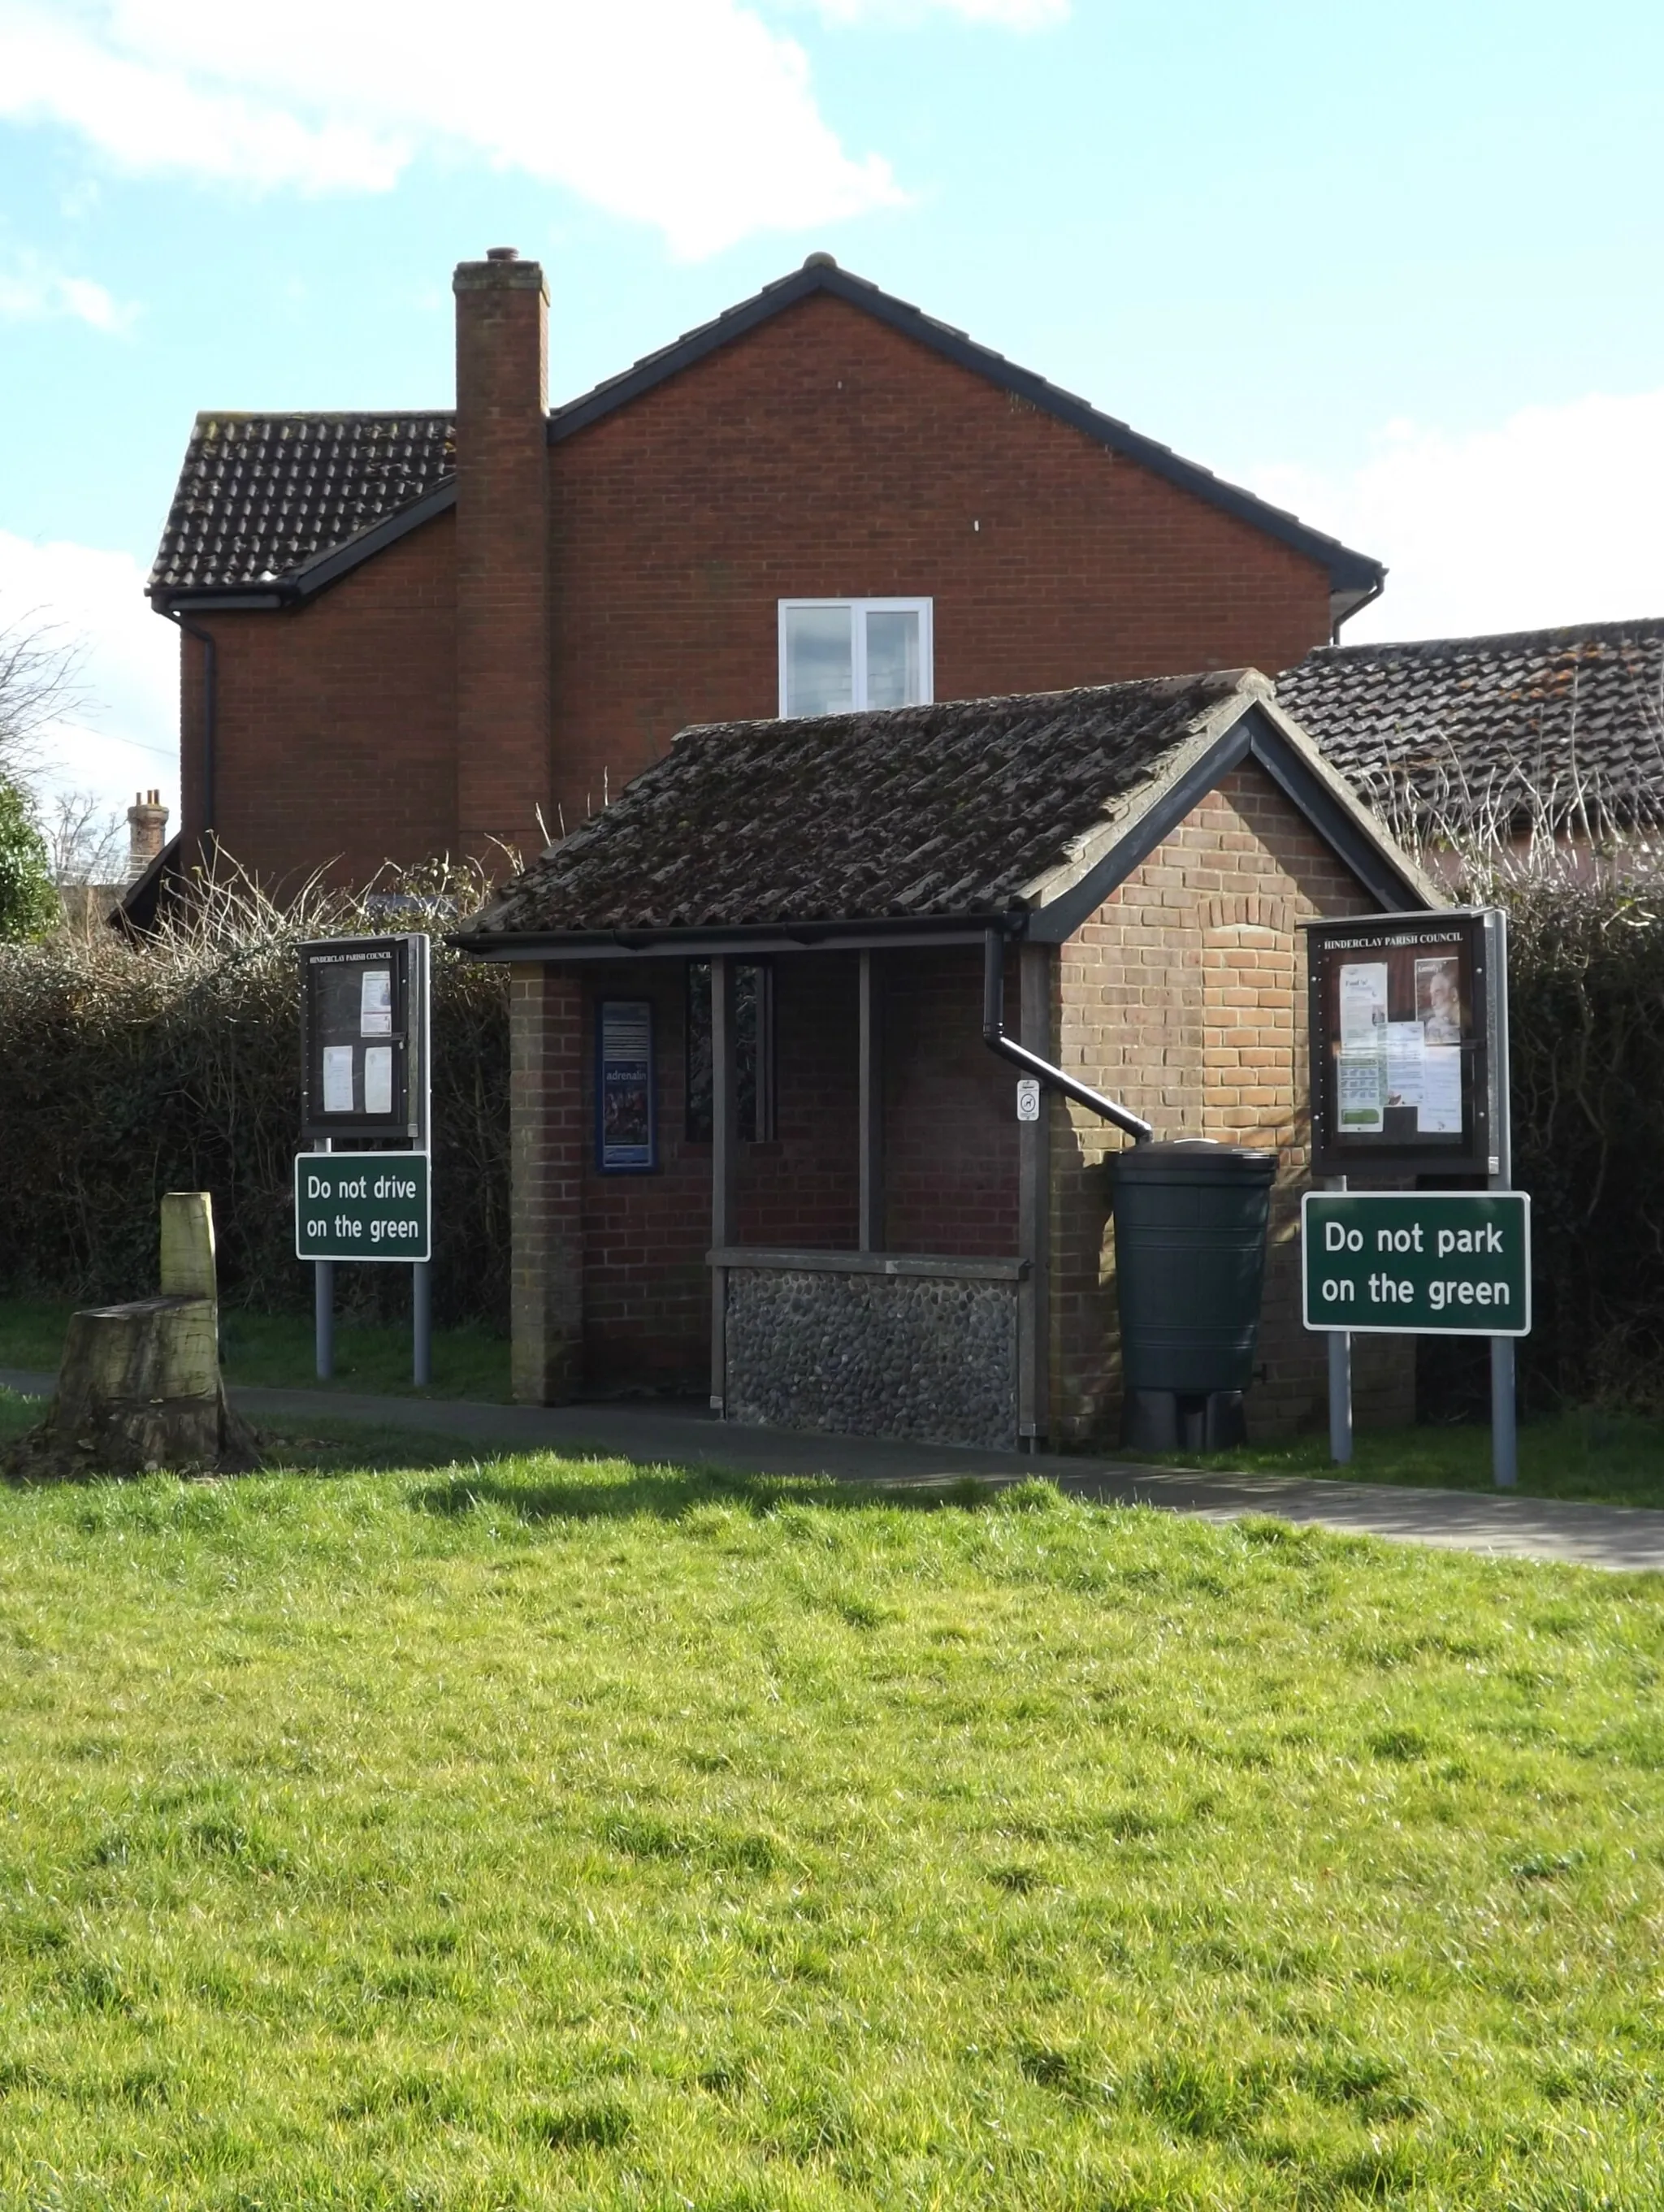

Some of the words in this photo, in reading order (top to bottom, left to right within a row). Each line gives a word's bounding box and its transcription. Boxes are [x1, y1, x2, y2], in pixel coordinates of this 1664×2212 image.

[1324, 937, 1384, 950] HINDERCLAY
[1385, 935, 1418, 946] PARISH
[1419, 932, 1462, 944] COUNCIL
[310, 954, 344, 964] HINDERCLAY
[345, 953, 366, 962] PARISH
[366, 951, 392, 960] COUNCIL
[606, 1069, 647, 1080] adrenalin
[308, 1175, 332, 1199] Do
[339, 1175, 366, 1199] not
[374, 1175, 417, 1199] drive
[307, 1219, 327, 1237] on
[335, 1214, 362, 1238] the
[370, 1219, 418, 1243] green
[1325, 1222, 1363, 1253] Do
[1378, 1223, 1424, 1253] not
[1437, 1223, 1504, 1258] park
[1322, 1278, 1354, 1302] on
[1368, 1272, 1415, 1304] the
[1428, 1281, 1510, 1310] green
